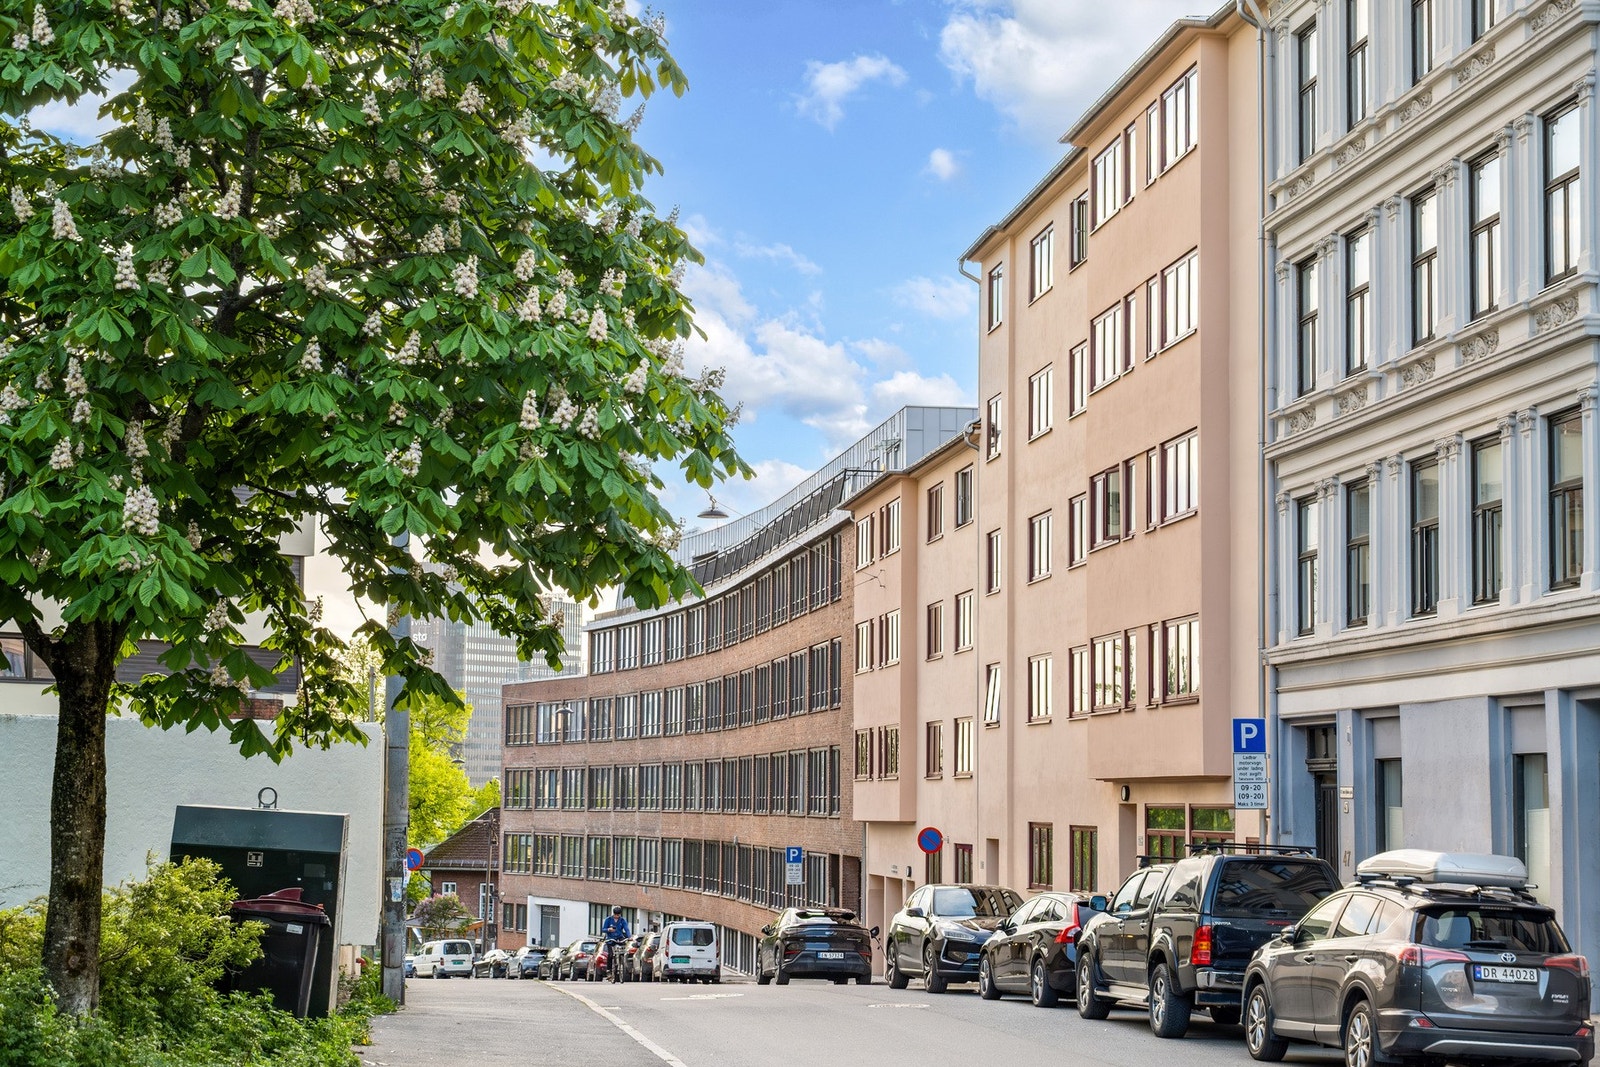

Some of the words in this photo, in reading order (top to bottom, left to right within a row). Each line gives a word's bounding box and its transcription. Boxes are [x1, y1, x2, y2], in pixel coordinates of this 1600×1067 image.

[1240, 722, 1258, 749] P
[789, 849, 799, 862] P
[1483, 967, 1497, 979] DR
[1502, 969, 1535, 981] 44028
